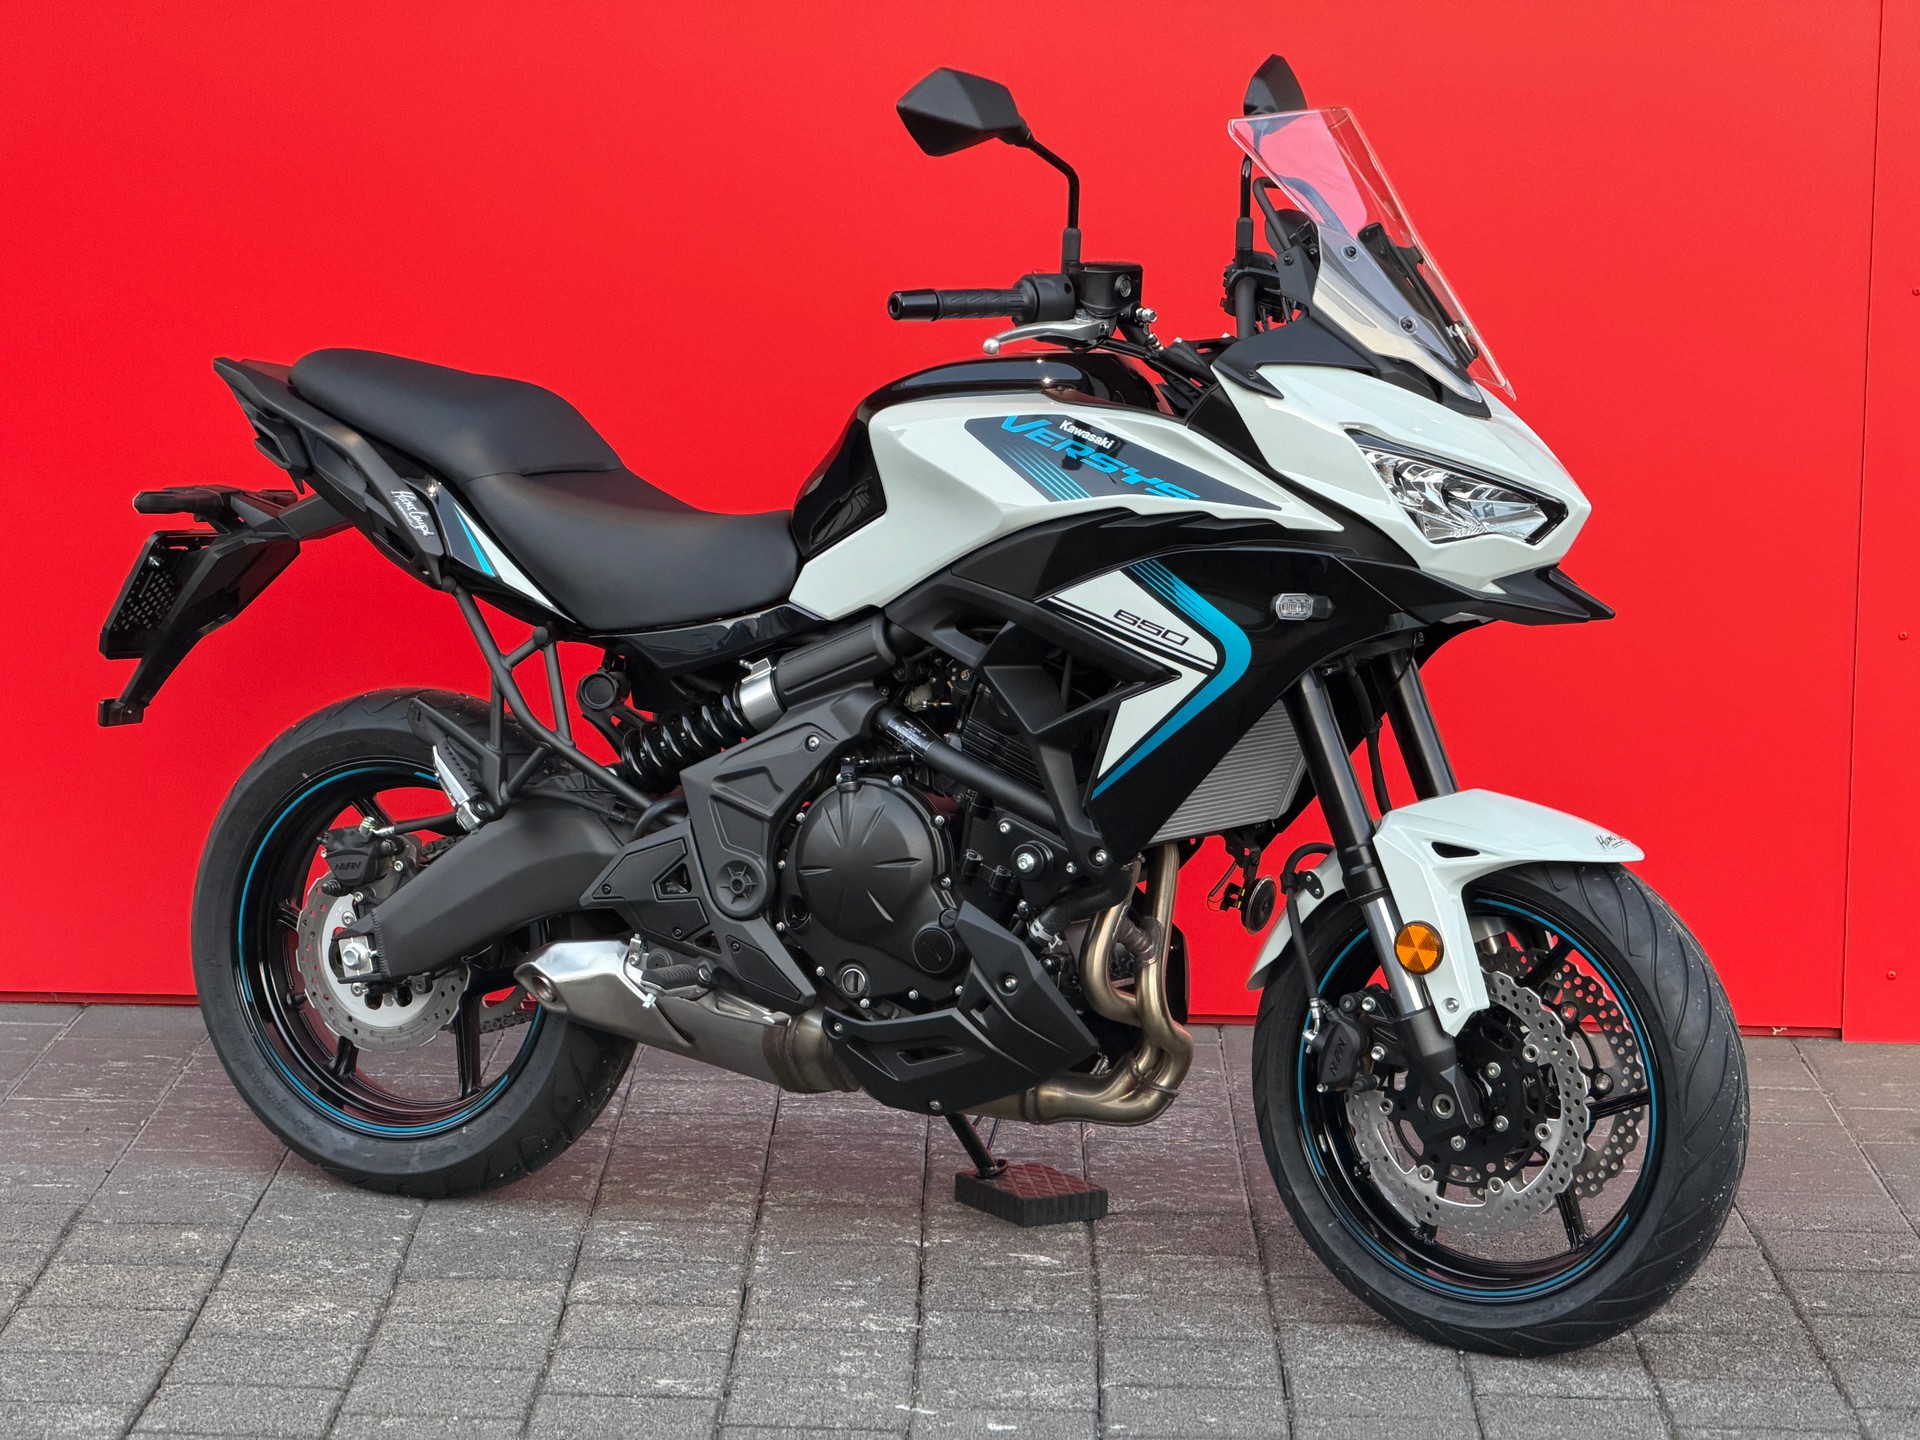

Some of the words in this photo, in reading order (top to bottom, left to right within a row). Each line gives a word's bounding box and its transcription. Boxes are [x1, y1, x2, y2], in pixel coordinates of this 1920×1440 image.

[1059, 419, 1116, 450] Kawasaki
[1001, 415, 1201, 500] VERSYS
[1113, 609, 1190, 647] 650
